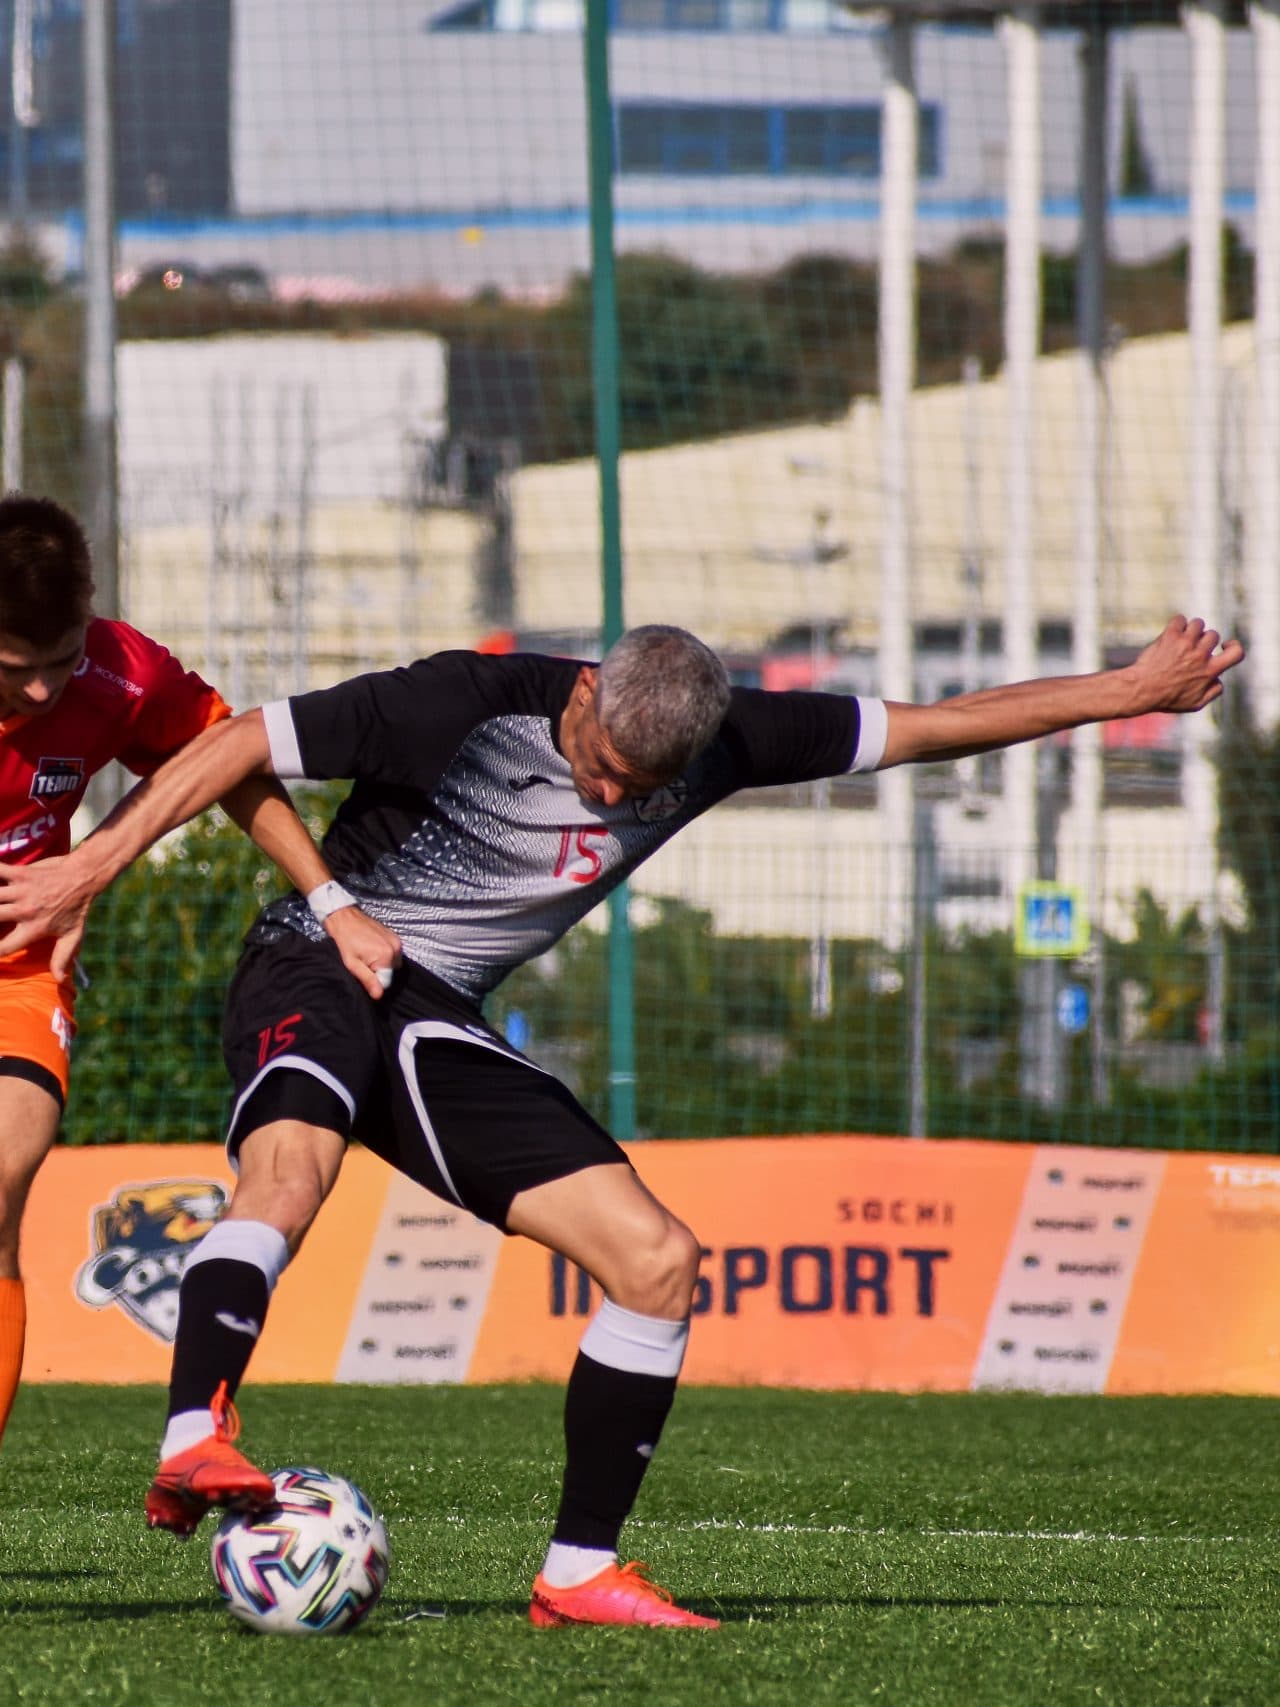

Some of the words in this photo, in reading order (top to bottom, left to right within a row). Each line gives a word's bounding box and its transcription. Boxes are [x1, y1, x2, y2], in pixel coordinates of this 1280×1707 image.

[37, 775, 79, 794] ТЕМП
[553, 825, 608, 884] 15
[258, 1013, 303, 1067] 15
